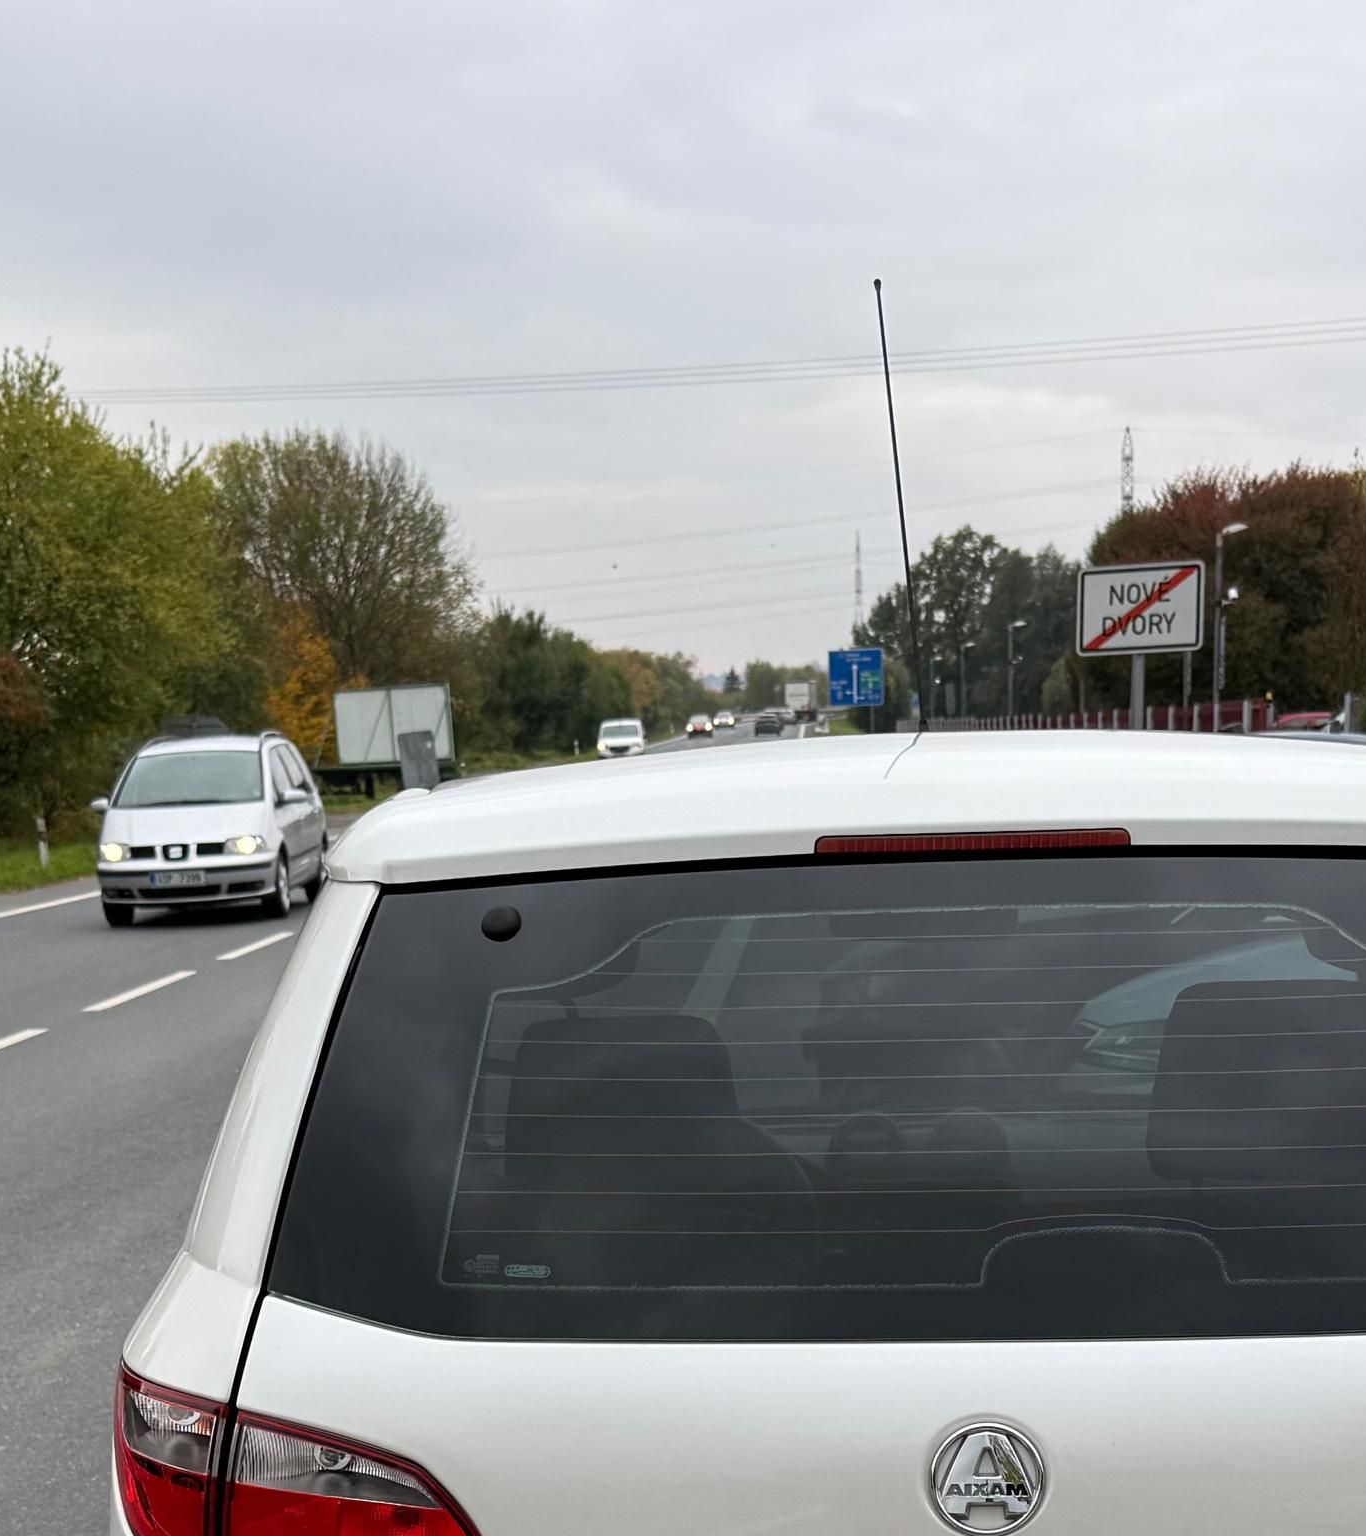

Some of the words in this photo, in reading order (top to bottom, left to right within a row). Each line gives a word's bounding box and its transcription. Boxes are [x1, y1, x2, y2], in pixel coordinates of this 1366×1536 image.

[1109, 576, 1171, 606] NOVÉ
[1102, 612, 1176, 636] DVORY
[945, 1482, 1029, 1496] AIXAM
